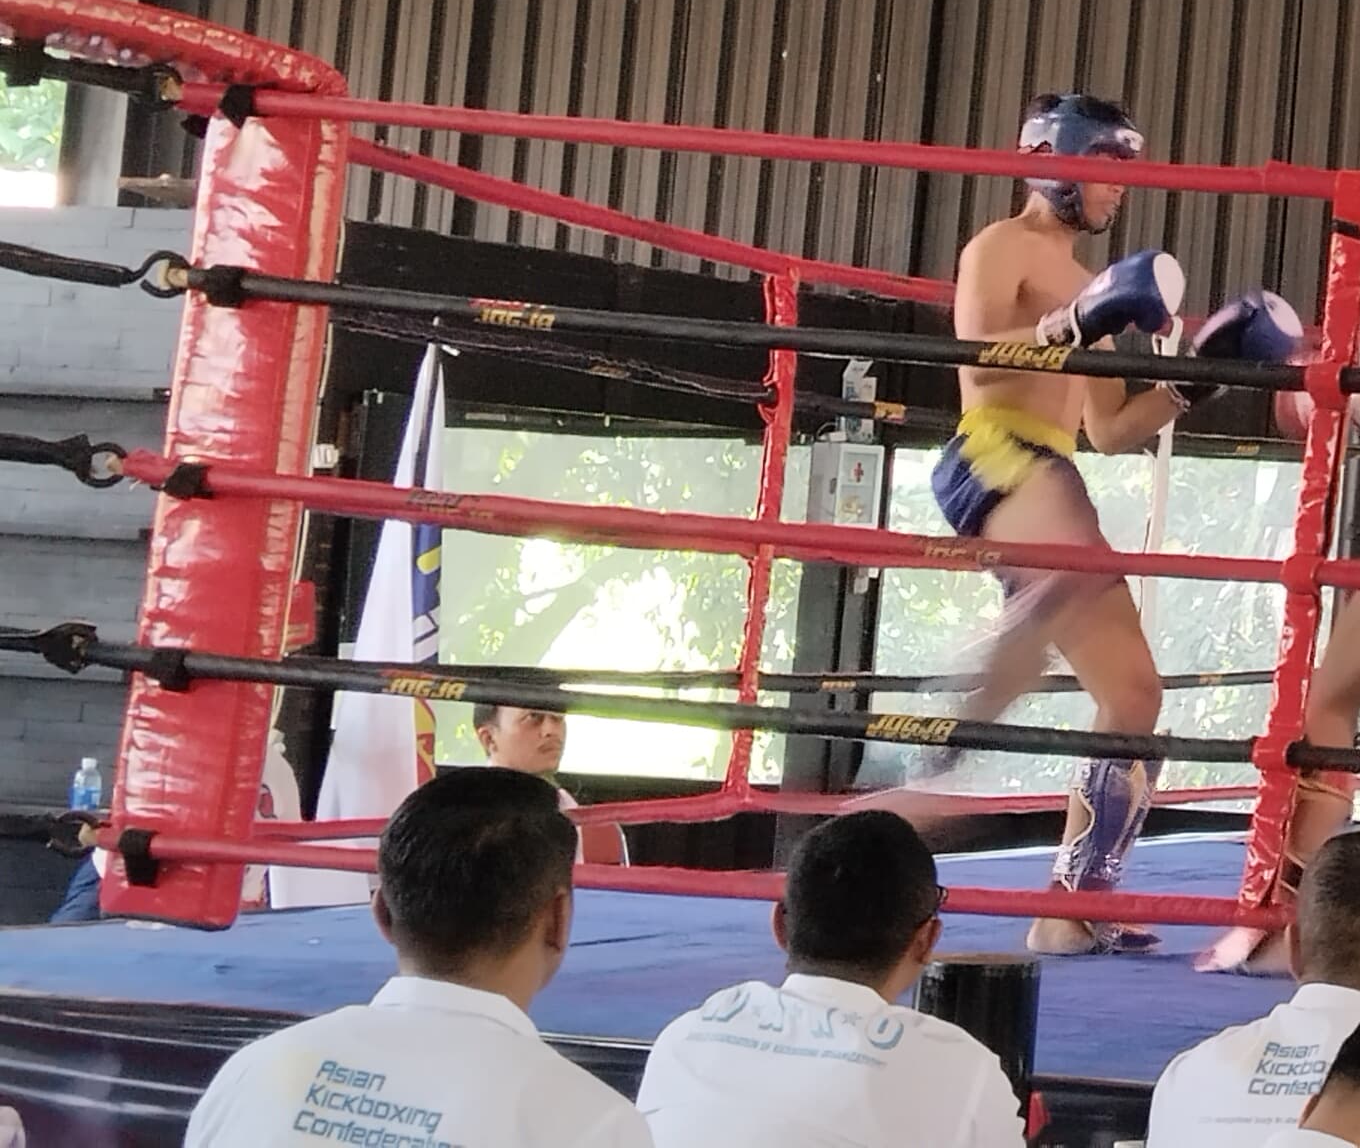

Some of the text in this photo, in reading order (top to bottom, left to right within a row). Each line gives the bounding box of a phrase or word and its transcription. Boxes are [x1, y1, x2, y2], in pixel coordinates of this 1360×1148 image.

[1263, 1041, 1320, 1059] Asian
[316, 1059, 387, 1092] Asian
[304, 1083, 443, 1134] Kickboxing
